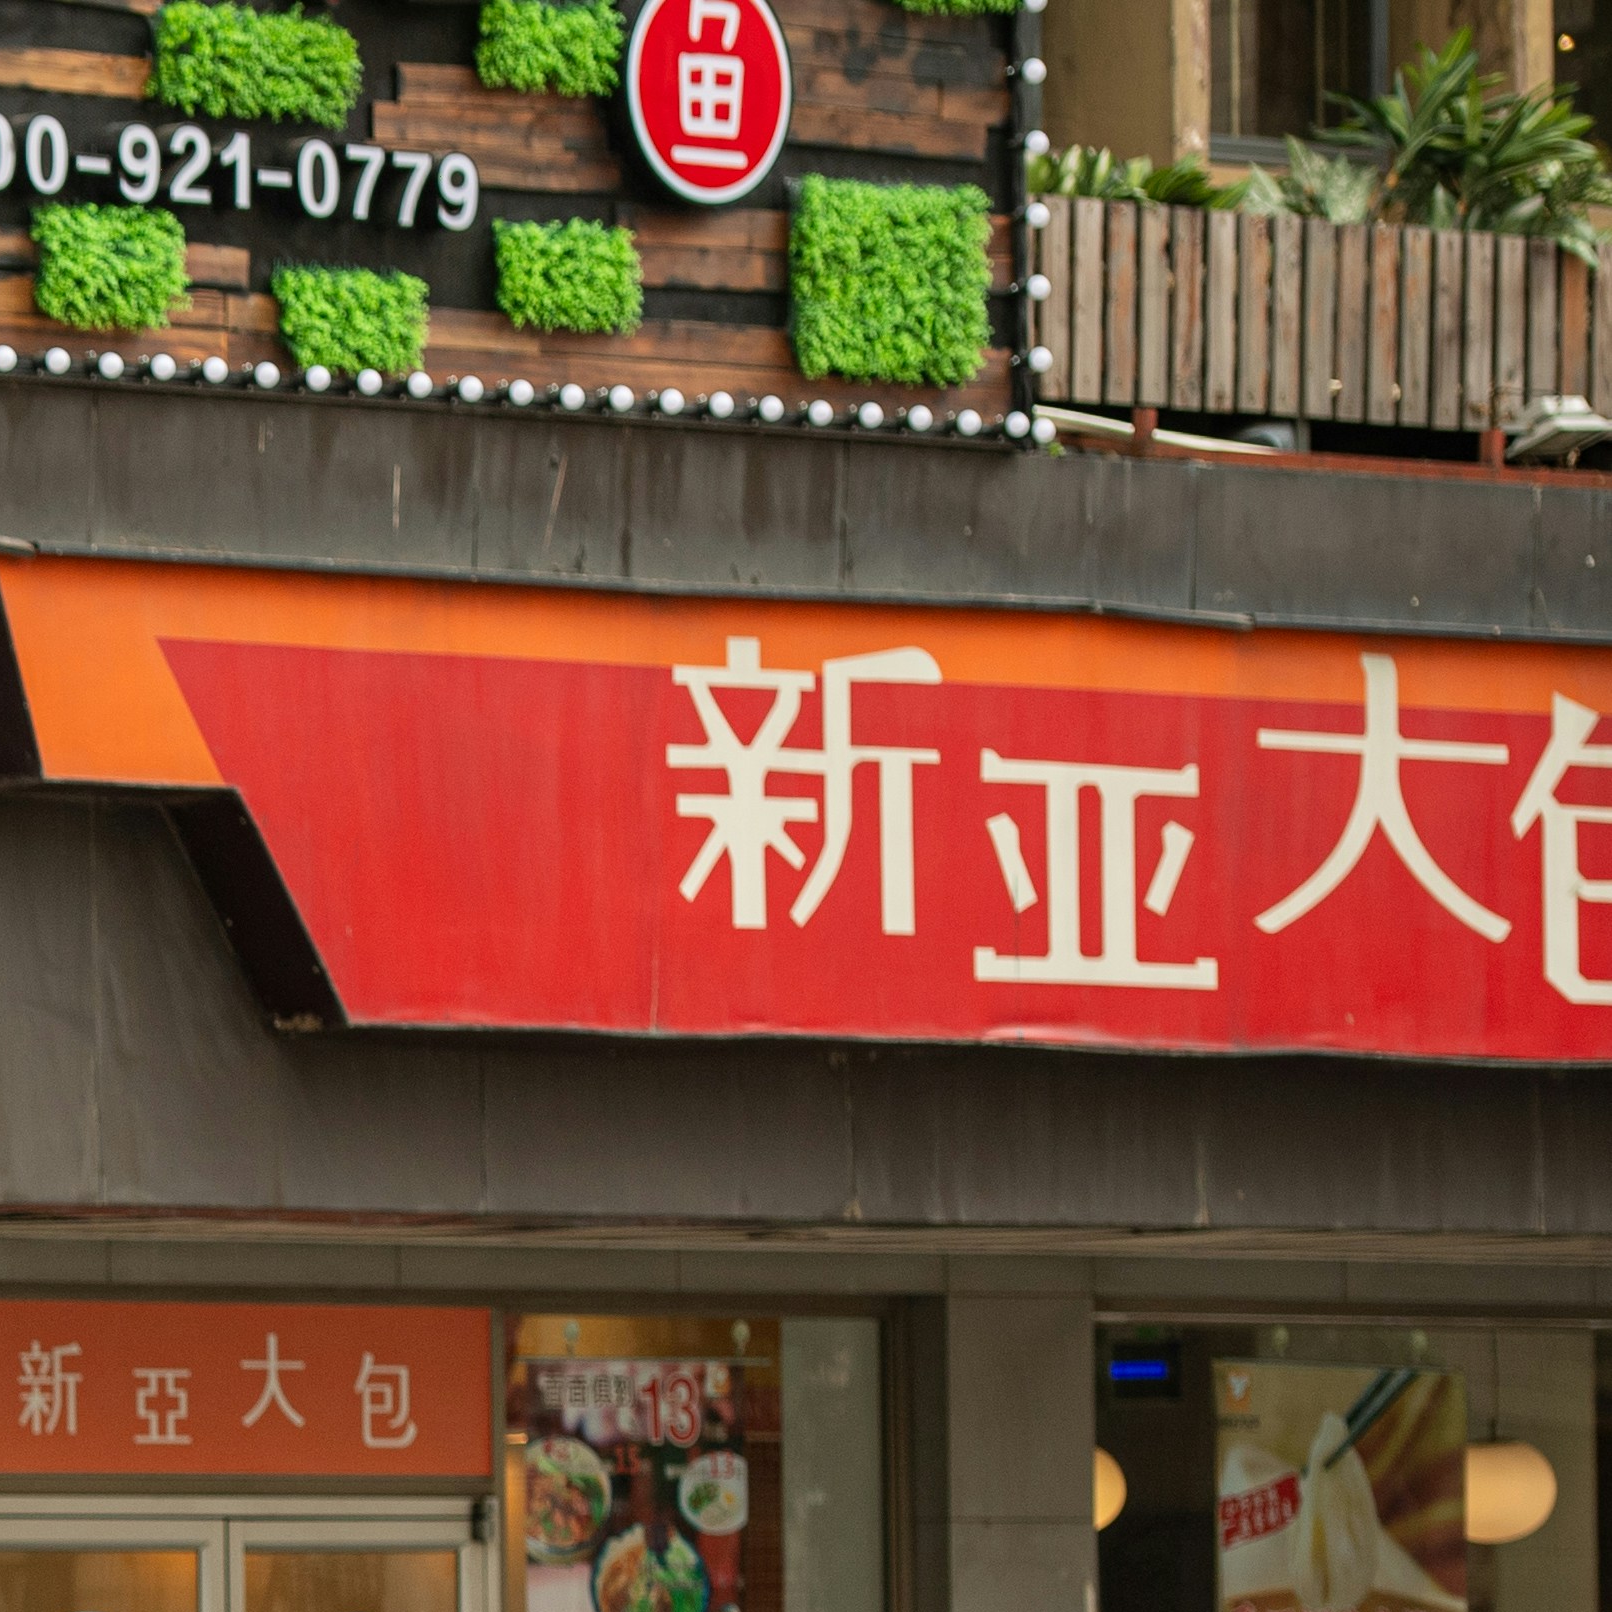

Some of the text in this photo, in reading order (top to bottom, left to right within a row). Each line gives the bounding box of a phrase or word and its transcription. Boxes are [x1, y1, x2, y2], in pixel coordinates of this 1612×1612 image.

[17, 1332, 418, 1448] 新亞大包
[640, 1373, 702, 1447] 13
